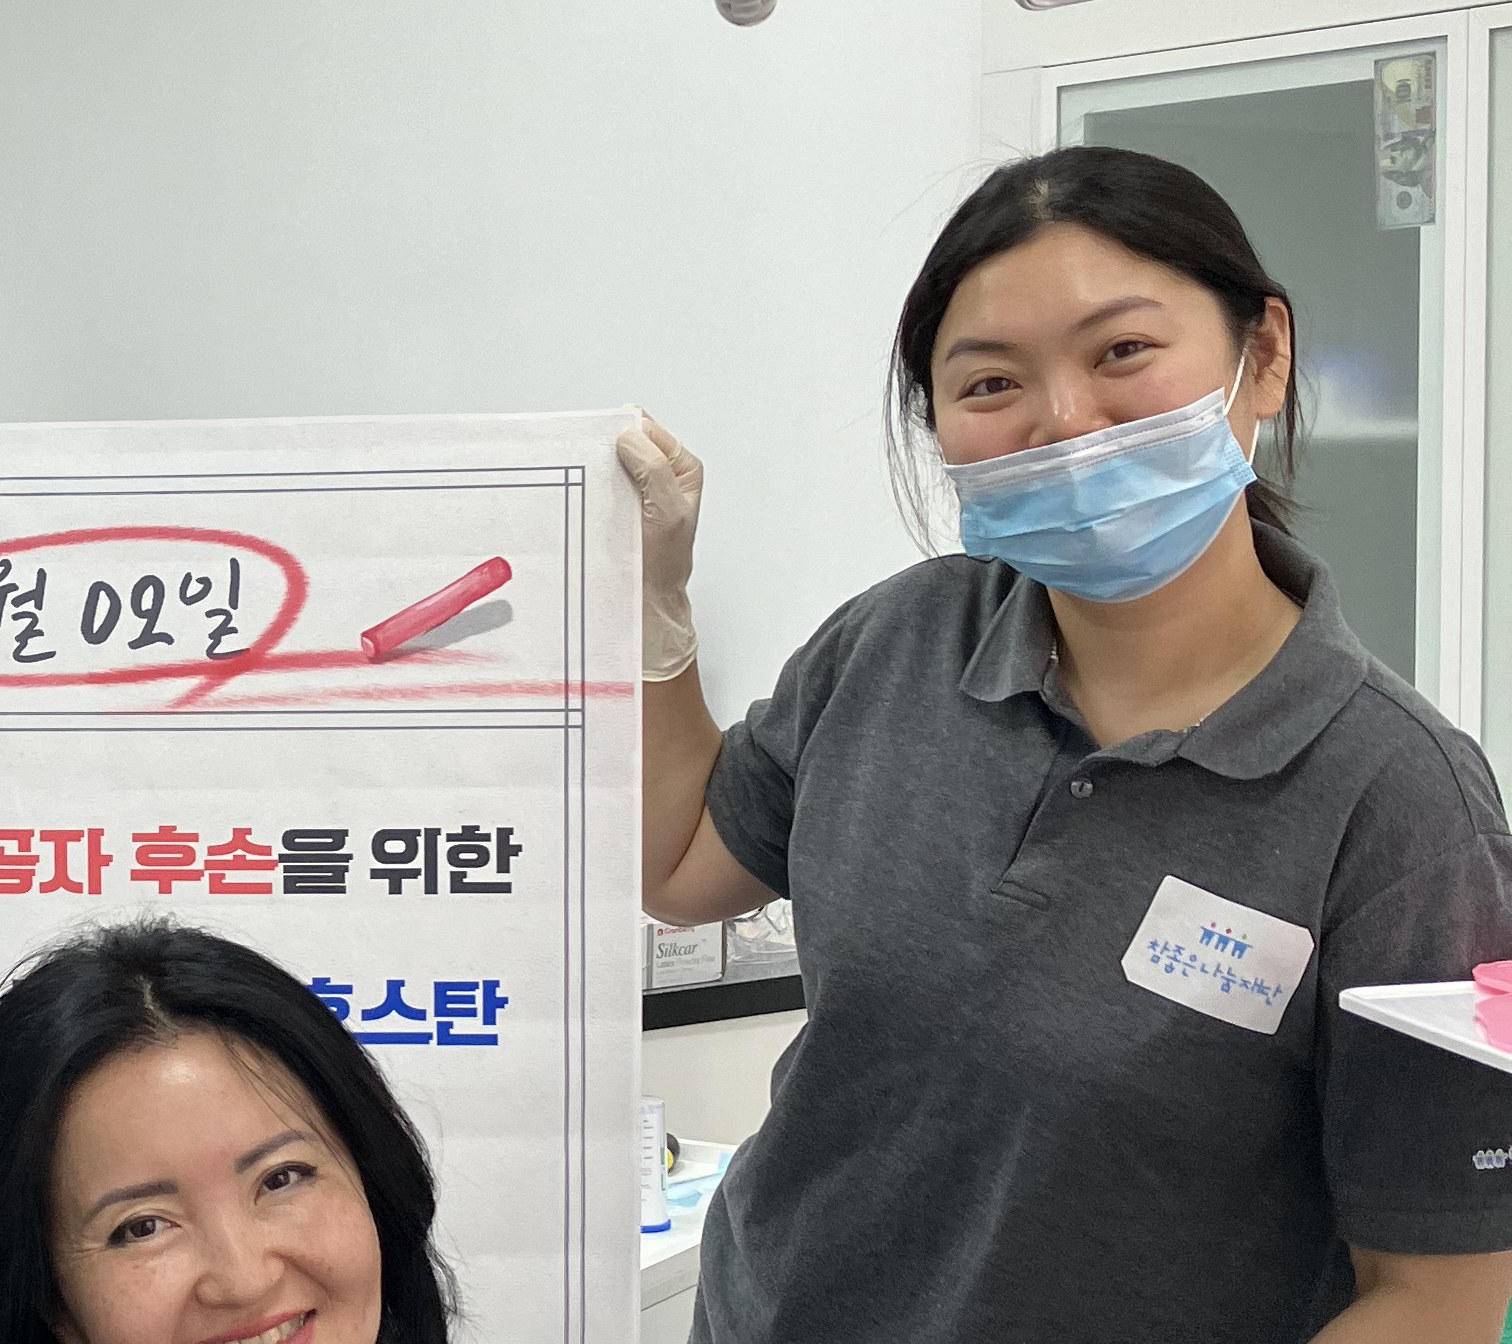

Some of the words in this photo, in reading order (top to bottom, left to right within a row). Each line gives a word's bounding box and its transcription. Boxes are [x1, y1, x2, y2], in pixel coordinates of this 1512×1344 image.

[80, 557, 252, 660] 02일
[130, 825, 353, 895] 후손을
[370, 825, 523, 895] 위한
